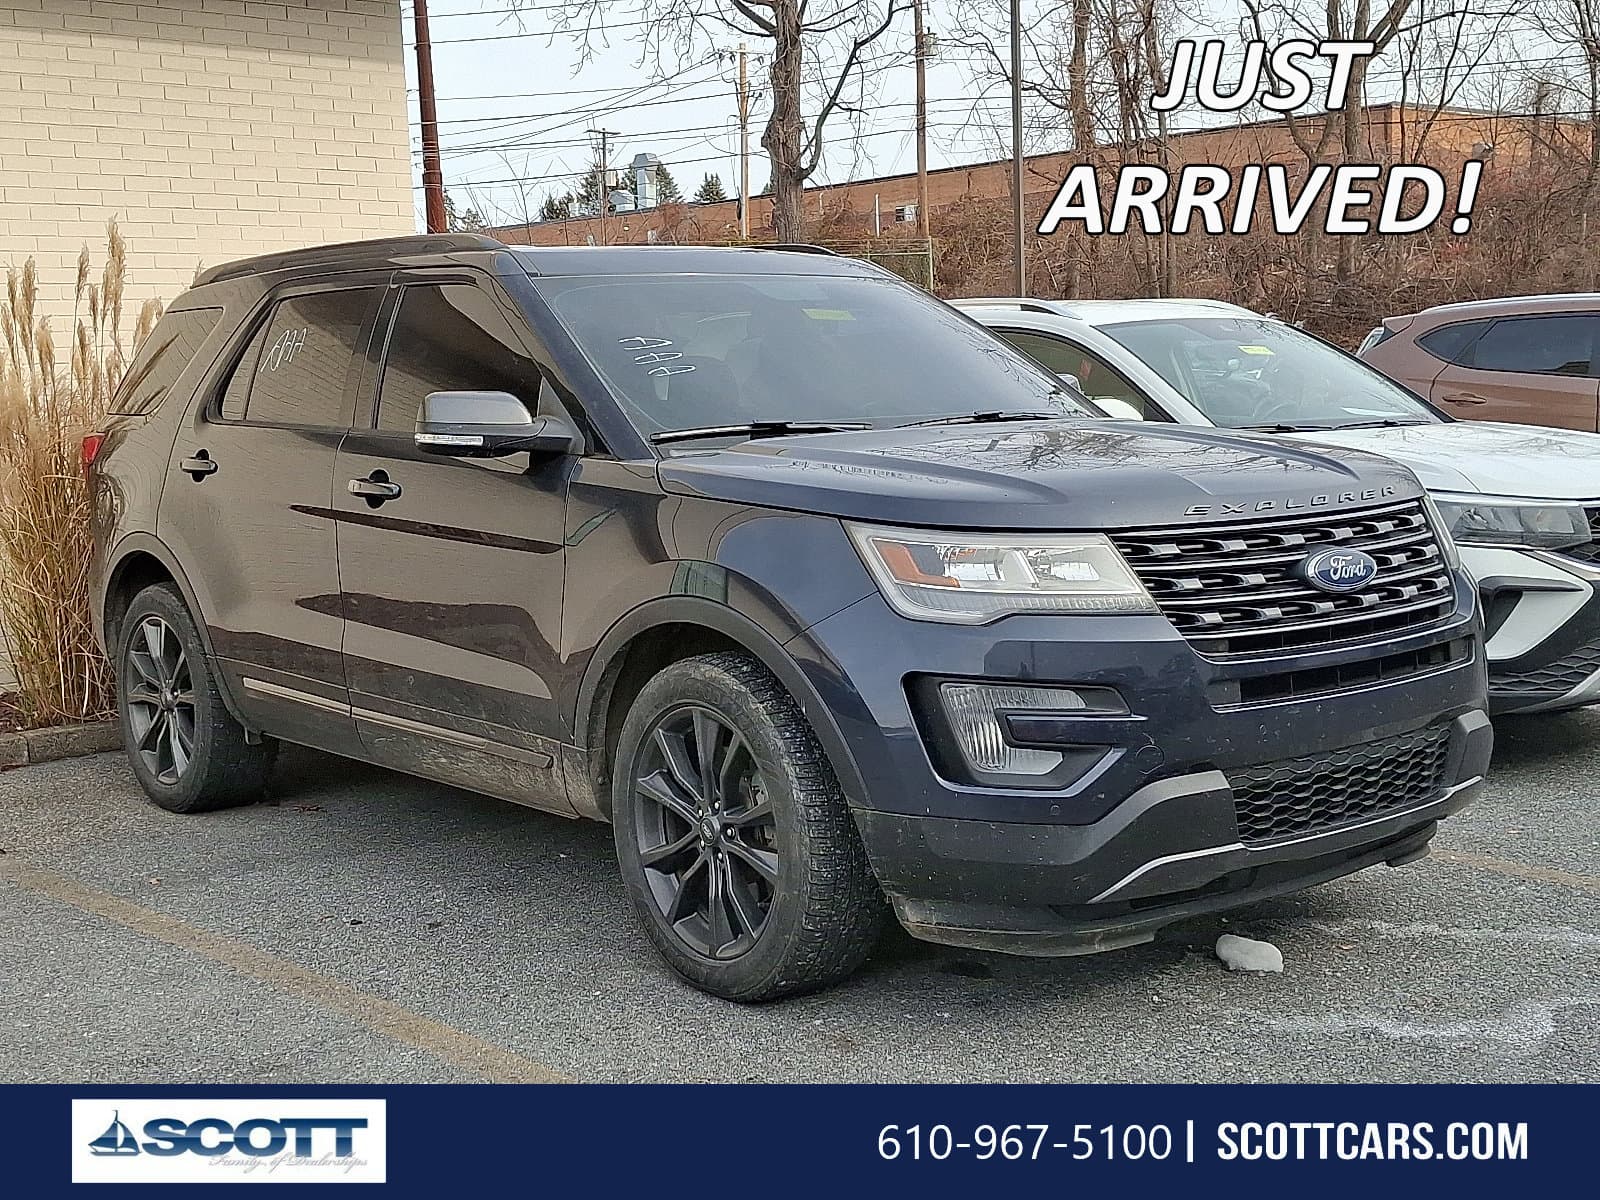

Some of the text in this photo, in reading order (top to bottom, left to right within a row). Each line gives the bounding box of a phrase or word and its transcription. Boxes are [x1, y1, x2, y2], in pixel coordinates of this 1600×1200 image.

[618, 336, 696, 377] AAA
[1183, 485, 1397, 517] EXPLORER
[1329, 555, 1367, 581] Ford
